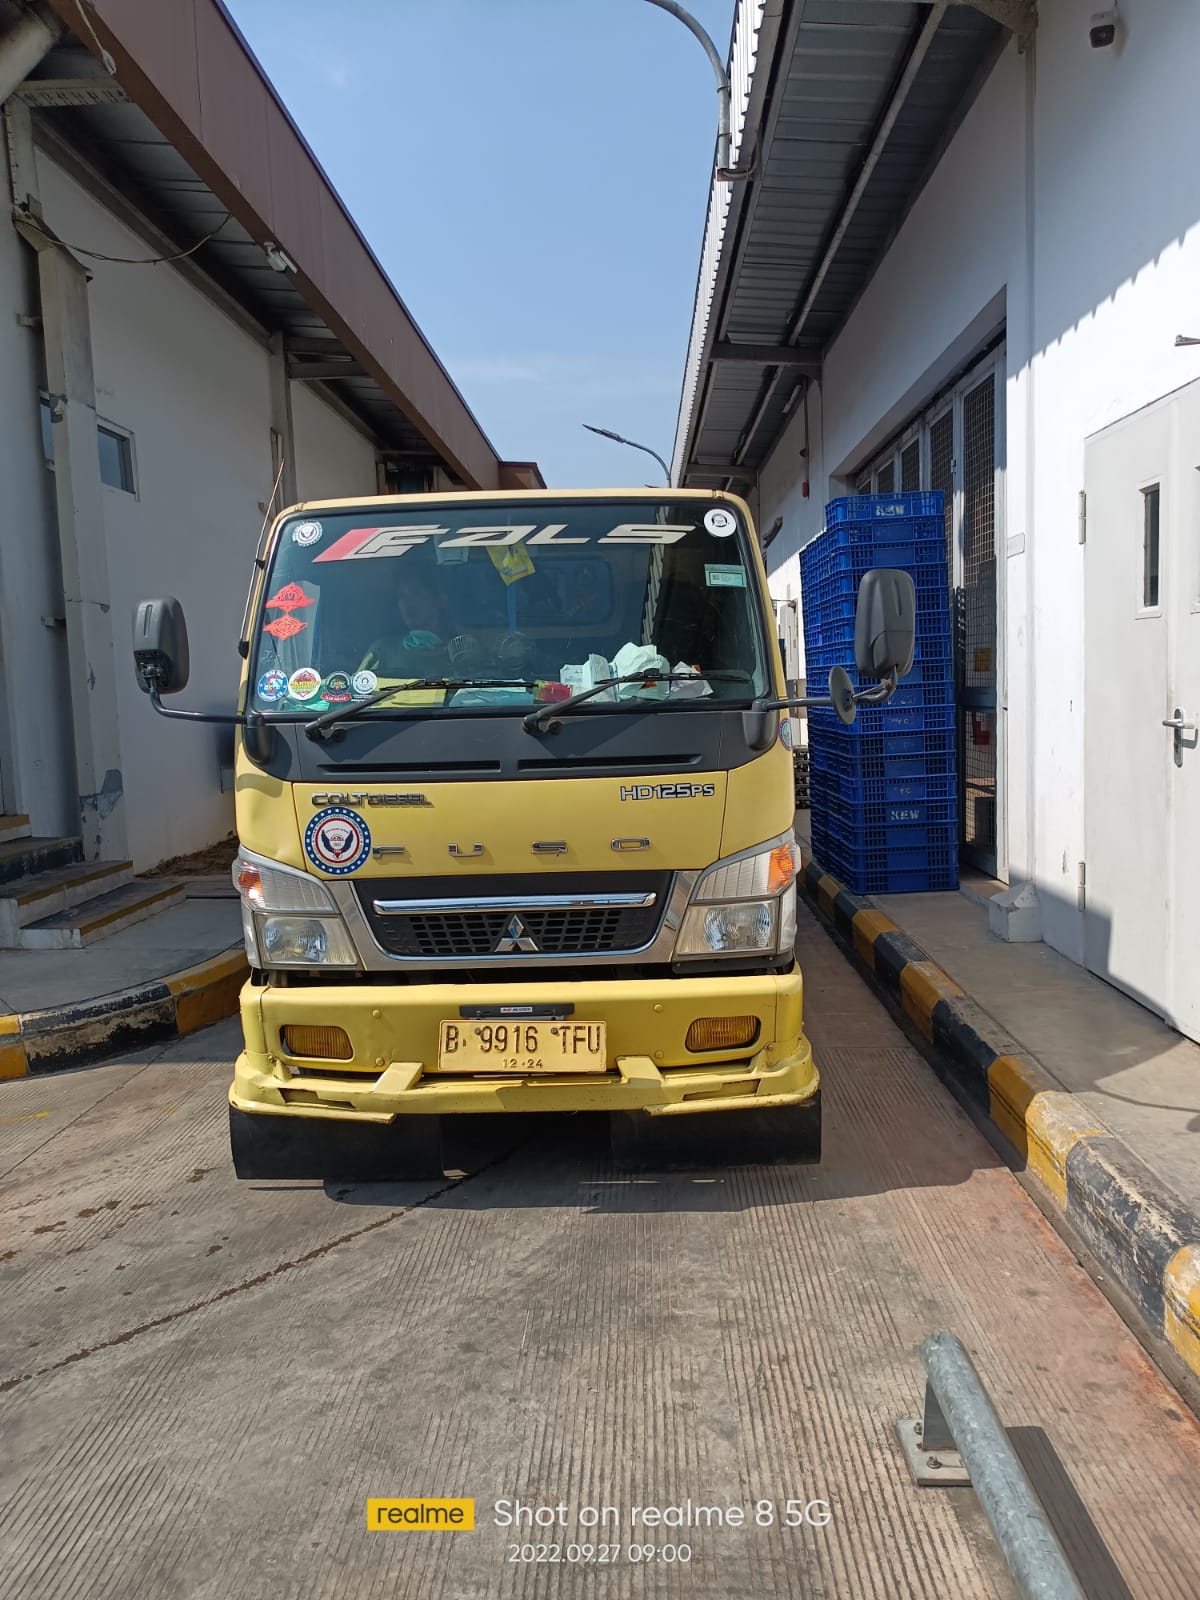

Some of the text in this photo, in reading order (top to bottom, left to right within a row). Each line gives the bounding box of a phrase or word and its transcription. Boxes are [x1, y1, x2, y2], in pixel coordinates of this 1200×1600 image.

[445, 1025, 601, 1054] B 9916 TFU
